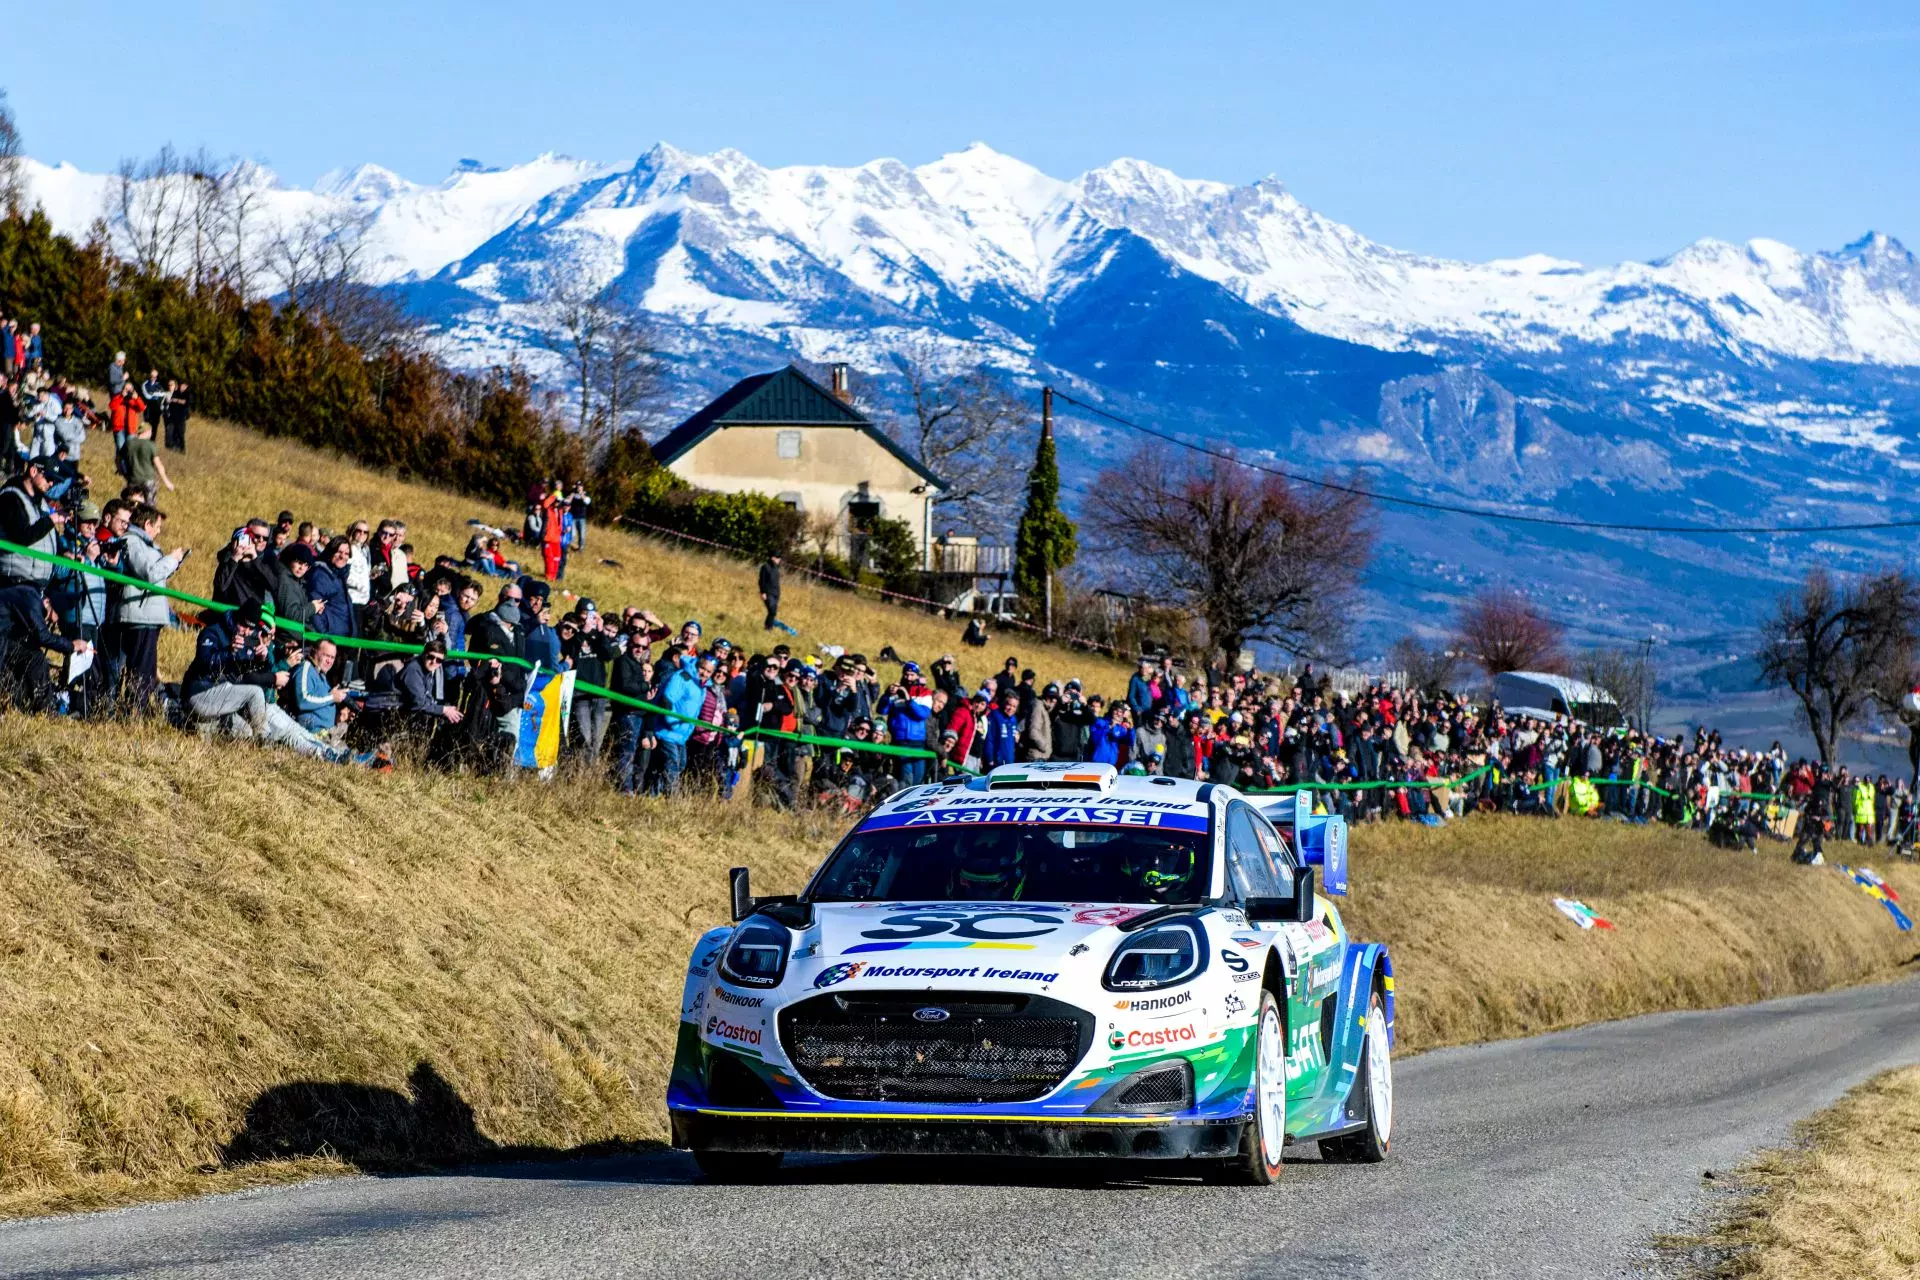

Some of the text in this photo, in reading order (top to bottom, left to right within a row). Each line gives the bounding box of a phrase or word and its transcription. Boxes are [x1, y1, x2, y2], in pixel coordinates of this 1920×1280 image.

[947, 797, 1193, 810] Motorsport Ireland
[904, 807, 1162, 827] AsahiKASEI
[863, 965, 1060, 984] Motorsport Ireland
[920, 1010, 940, 1019] Ford
[715, 1020, 762, 1046] Castrol
[1127, 1023, 1197, 1047] Castrol
